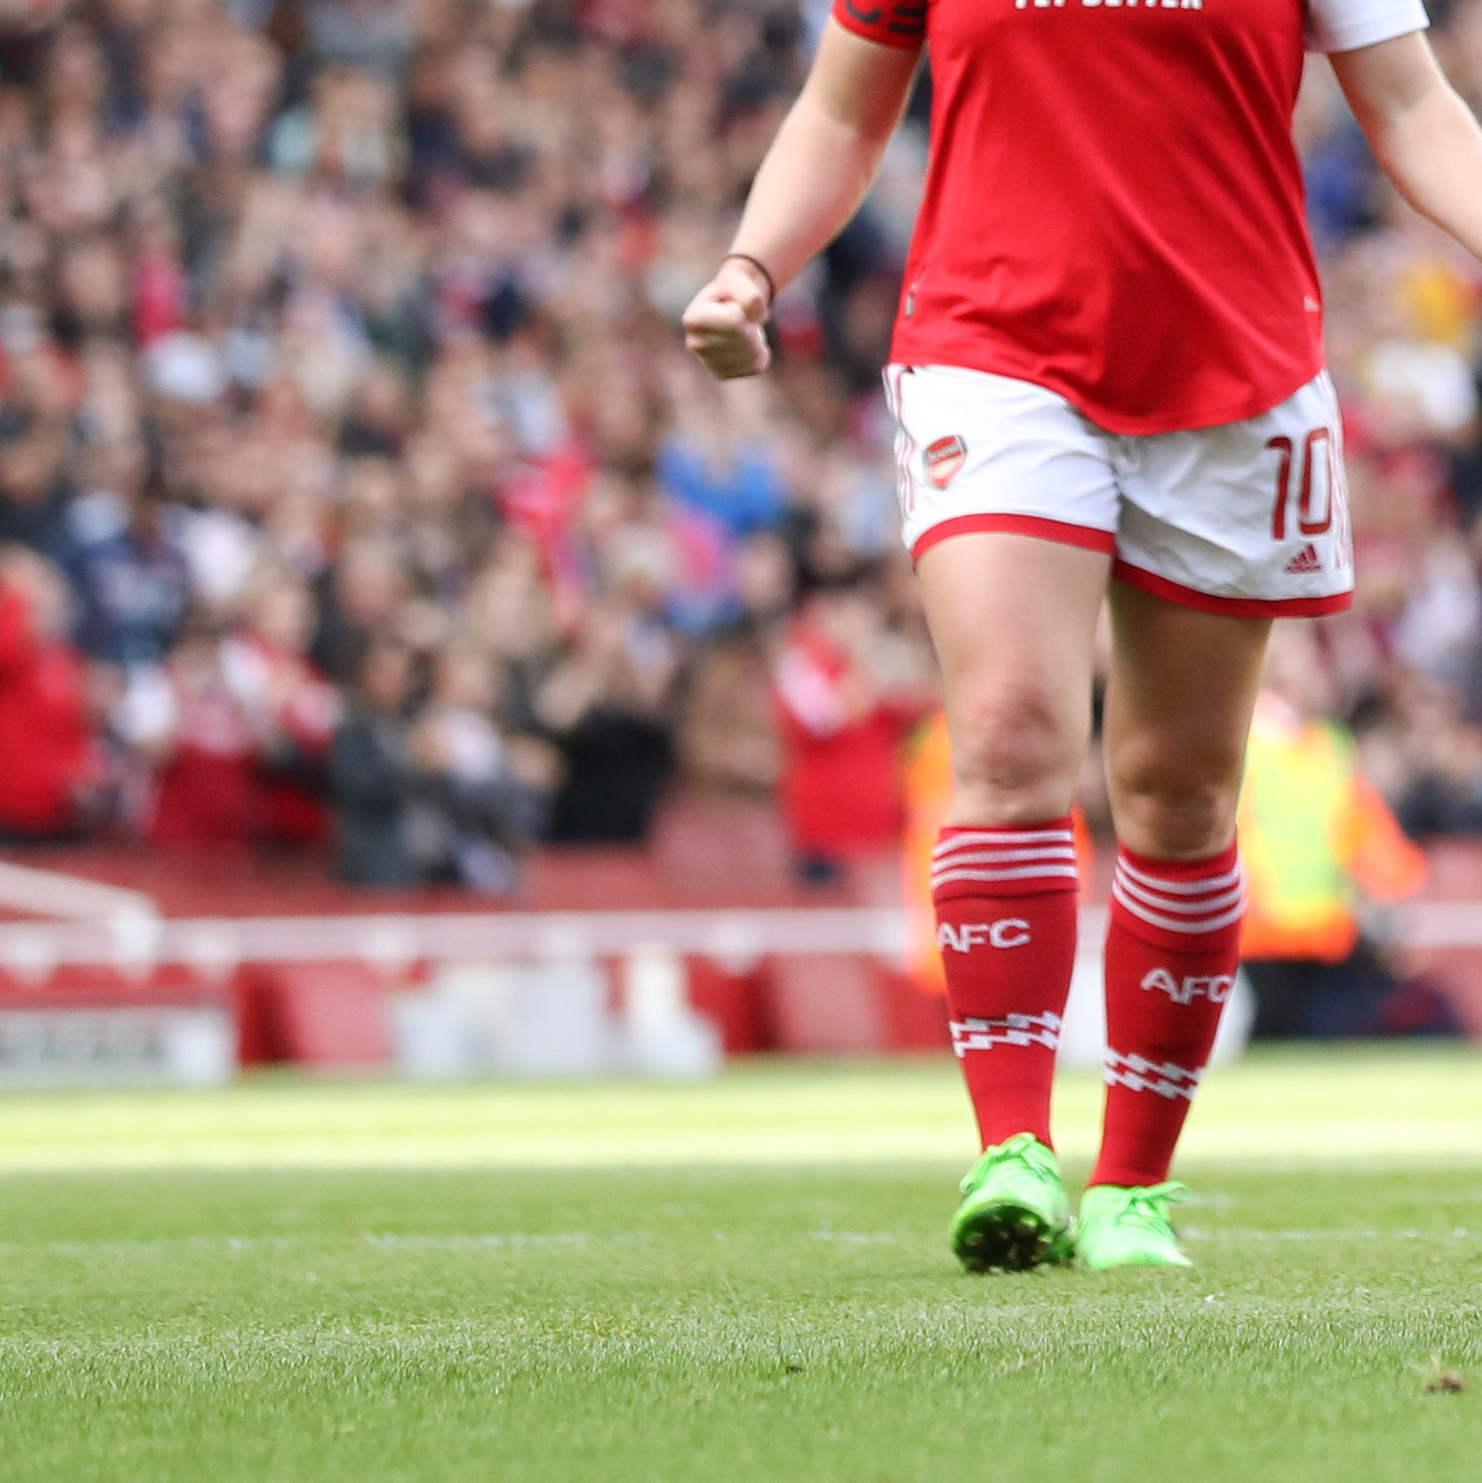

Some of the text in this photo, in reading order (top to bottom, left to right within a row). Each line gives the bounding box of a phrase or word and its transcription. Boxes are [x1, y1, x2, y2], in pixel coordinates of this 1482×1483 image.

[1266, 427, 1332, 541] 10
[937, 918, 1031, 954] AFC
[1140, 968, 1236, 1006] AFC
